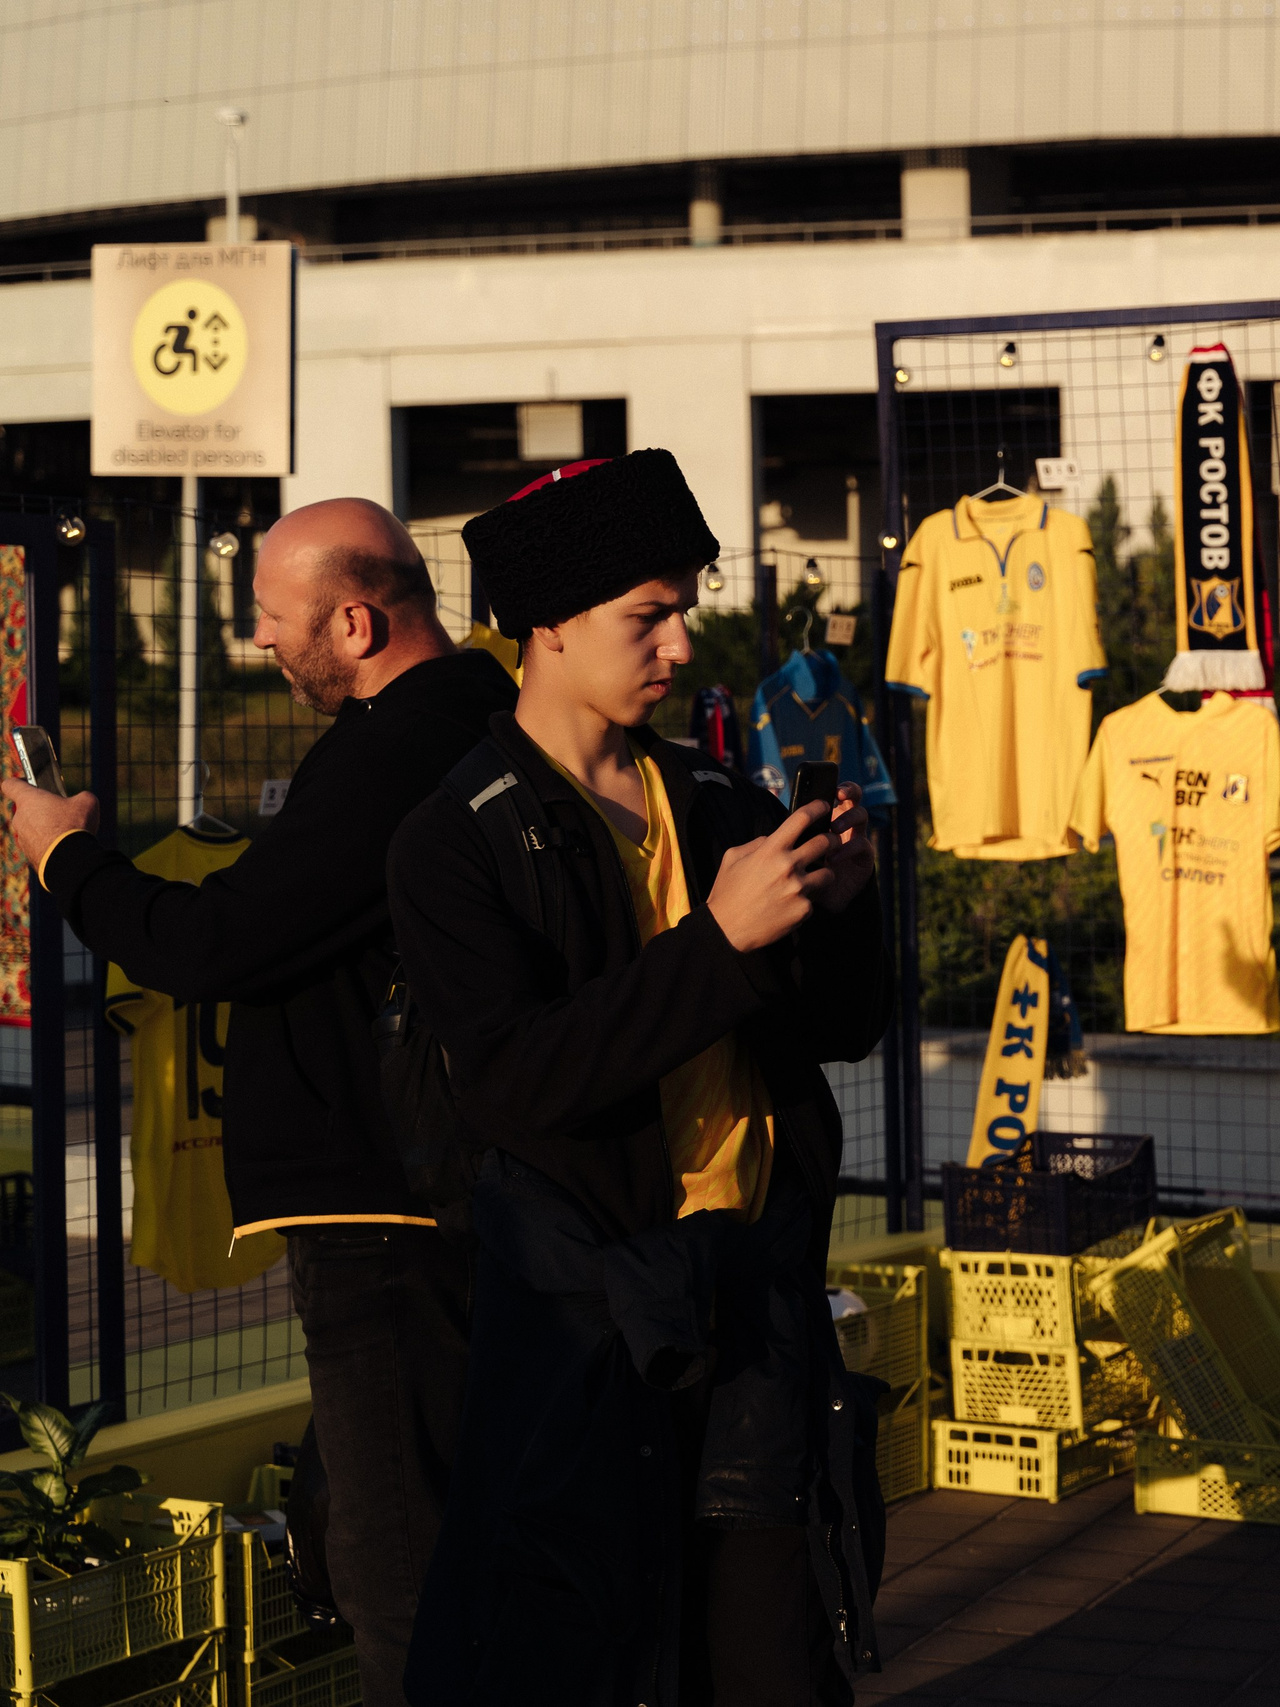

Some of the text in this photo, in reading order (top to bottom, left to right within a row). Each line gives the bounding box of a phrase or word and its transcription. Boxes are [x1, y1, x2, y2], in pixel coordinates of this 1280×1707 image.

[116, 247, 267, 270] Лифт для МГН
[135, 420, 242, 442] Elevator for
[112, 445, 266, 468] disabled persons
[1196, 367, 1231, 571] ФК РОСТОВ
